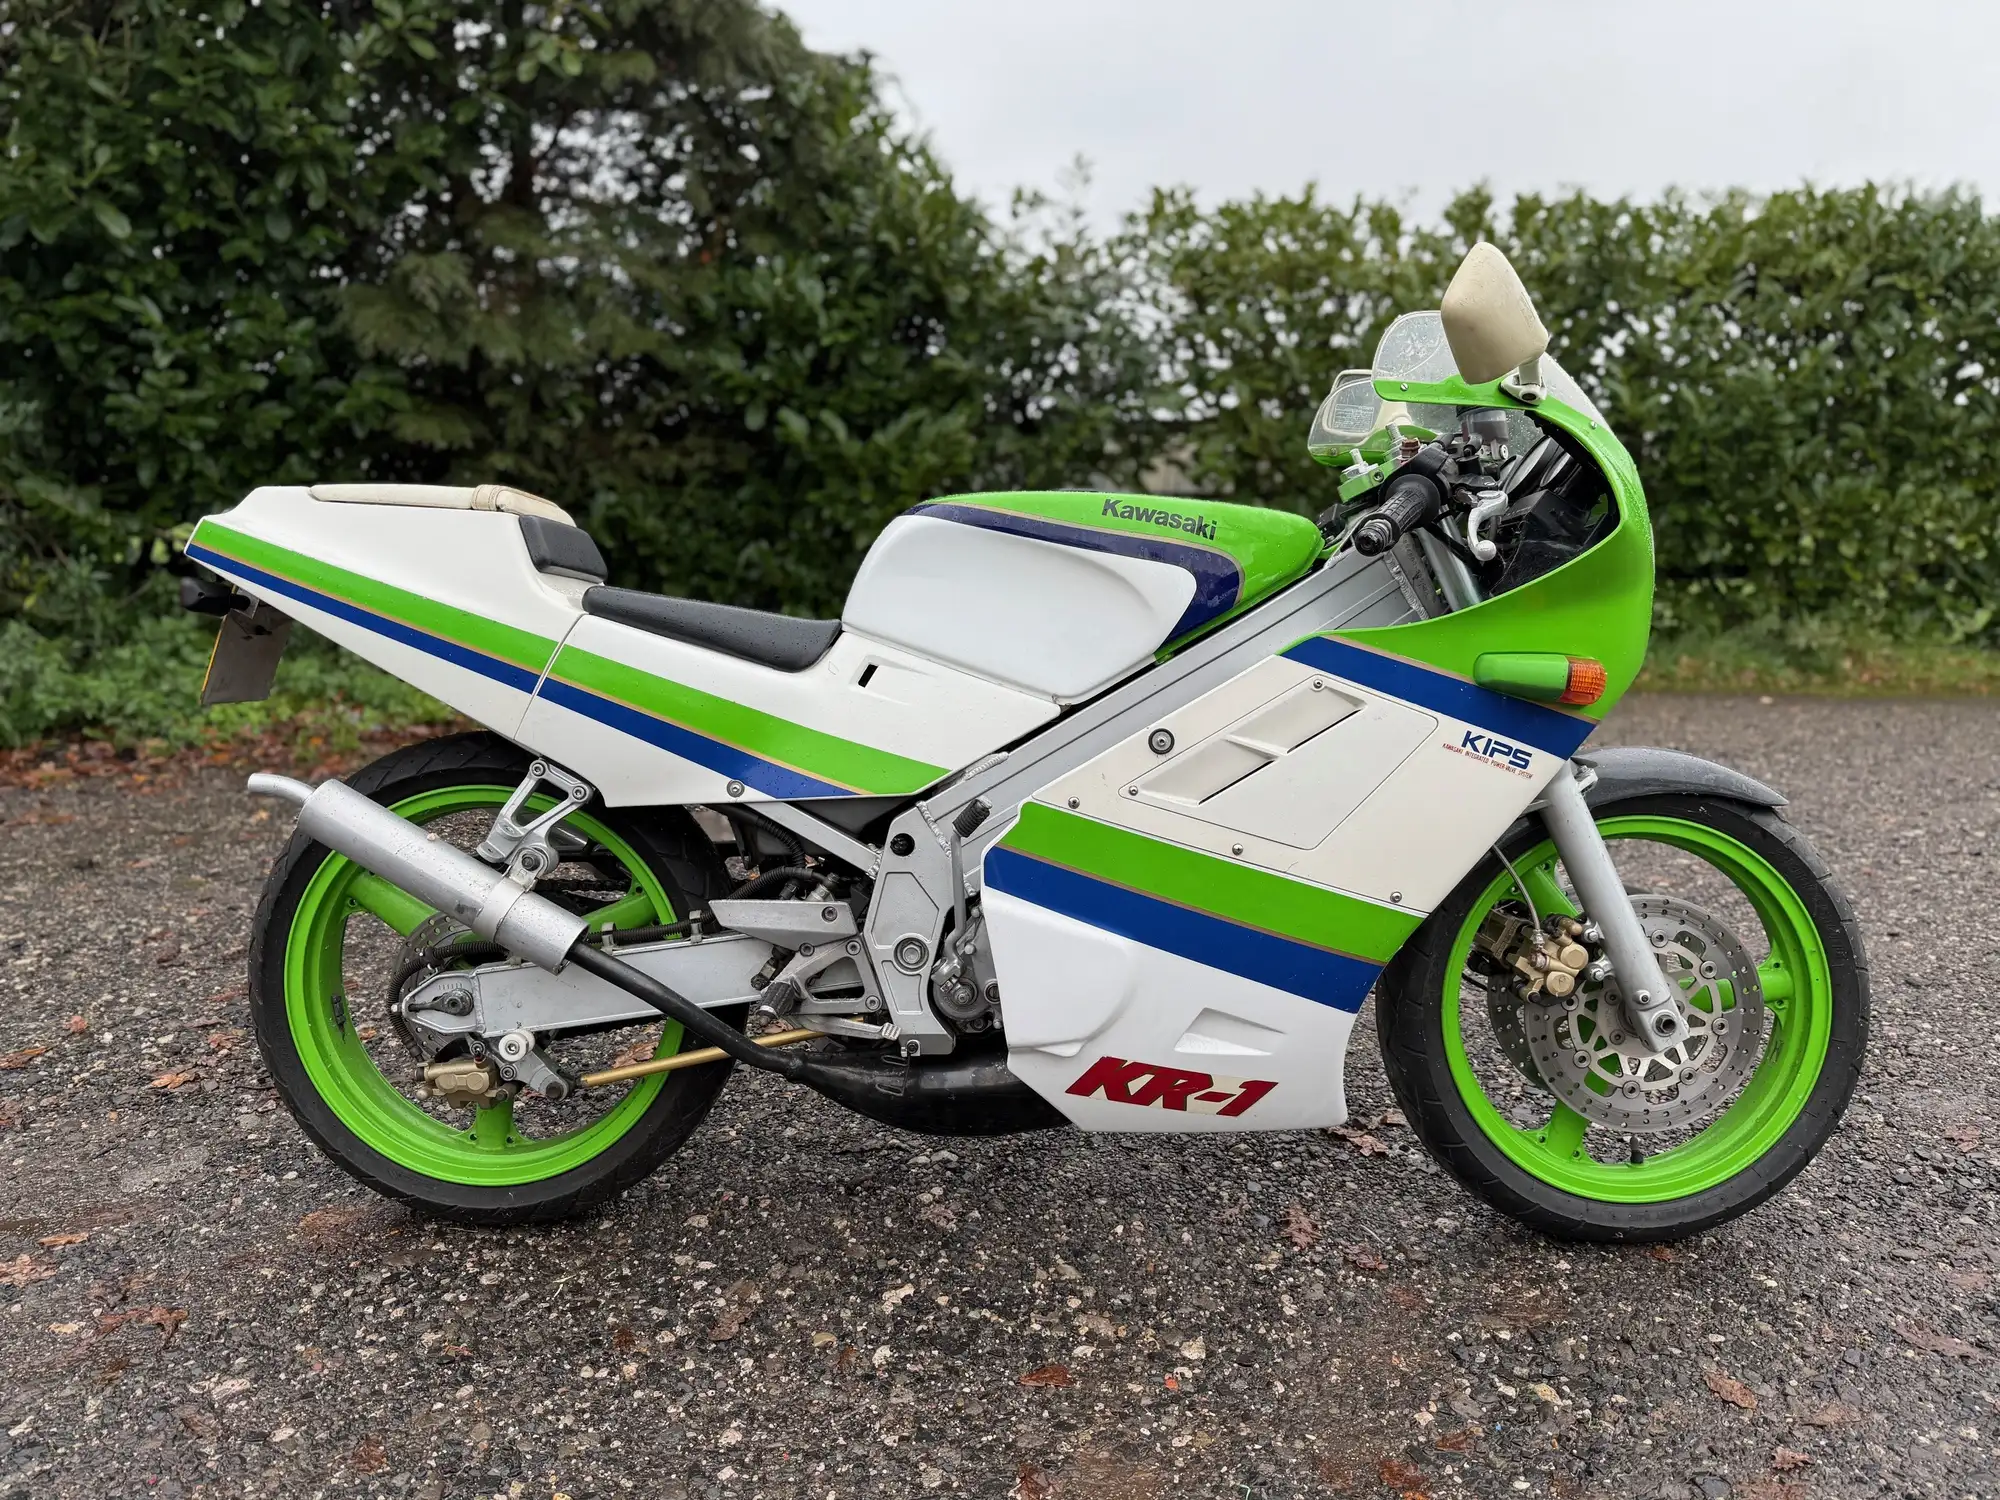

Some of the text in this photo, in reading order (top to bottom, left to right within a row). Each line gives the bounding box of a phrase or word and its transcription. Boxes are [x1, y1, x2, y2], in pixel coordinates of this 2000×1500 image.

[1102, 498, 1218, 541] Kawasaki
[1461, 730, 1533, 770] KIPS
[1465, 750, 1490, 764] INTEGRATED
[1517, 769, 1534, 780] SYSTEM
[1065, 1056, 1279, 1117] KR-1
